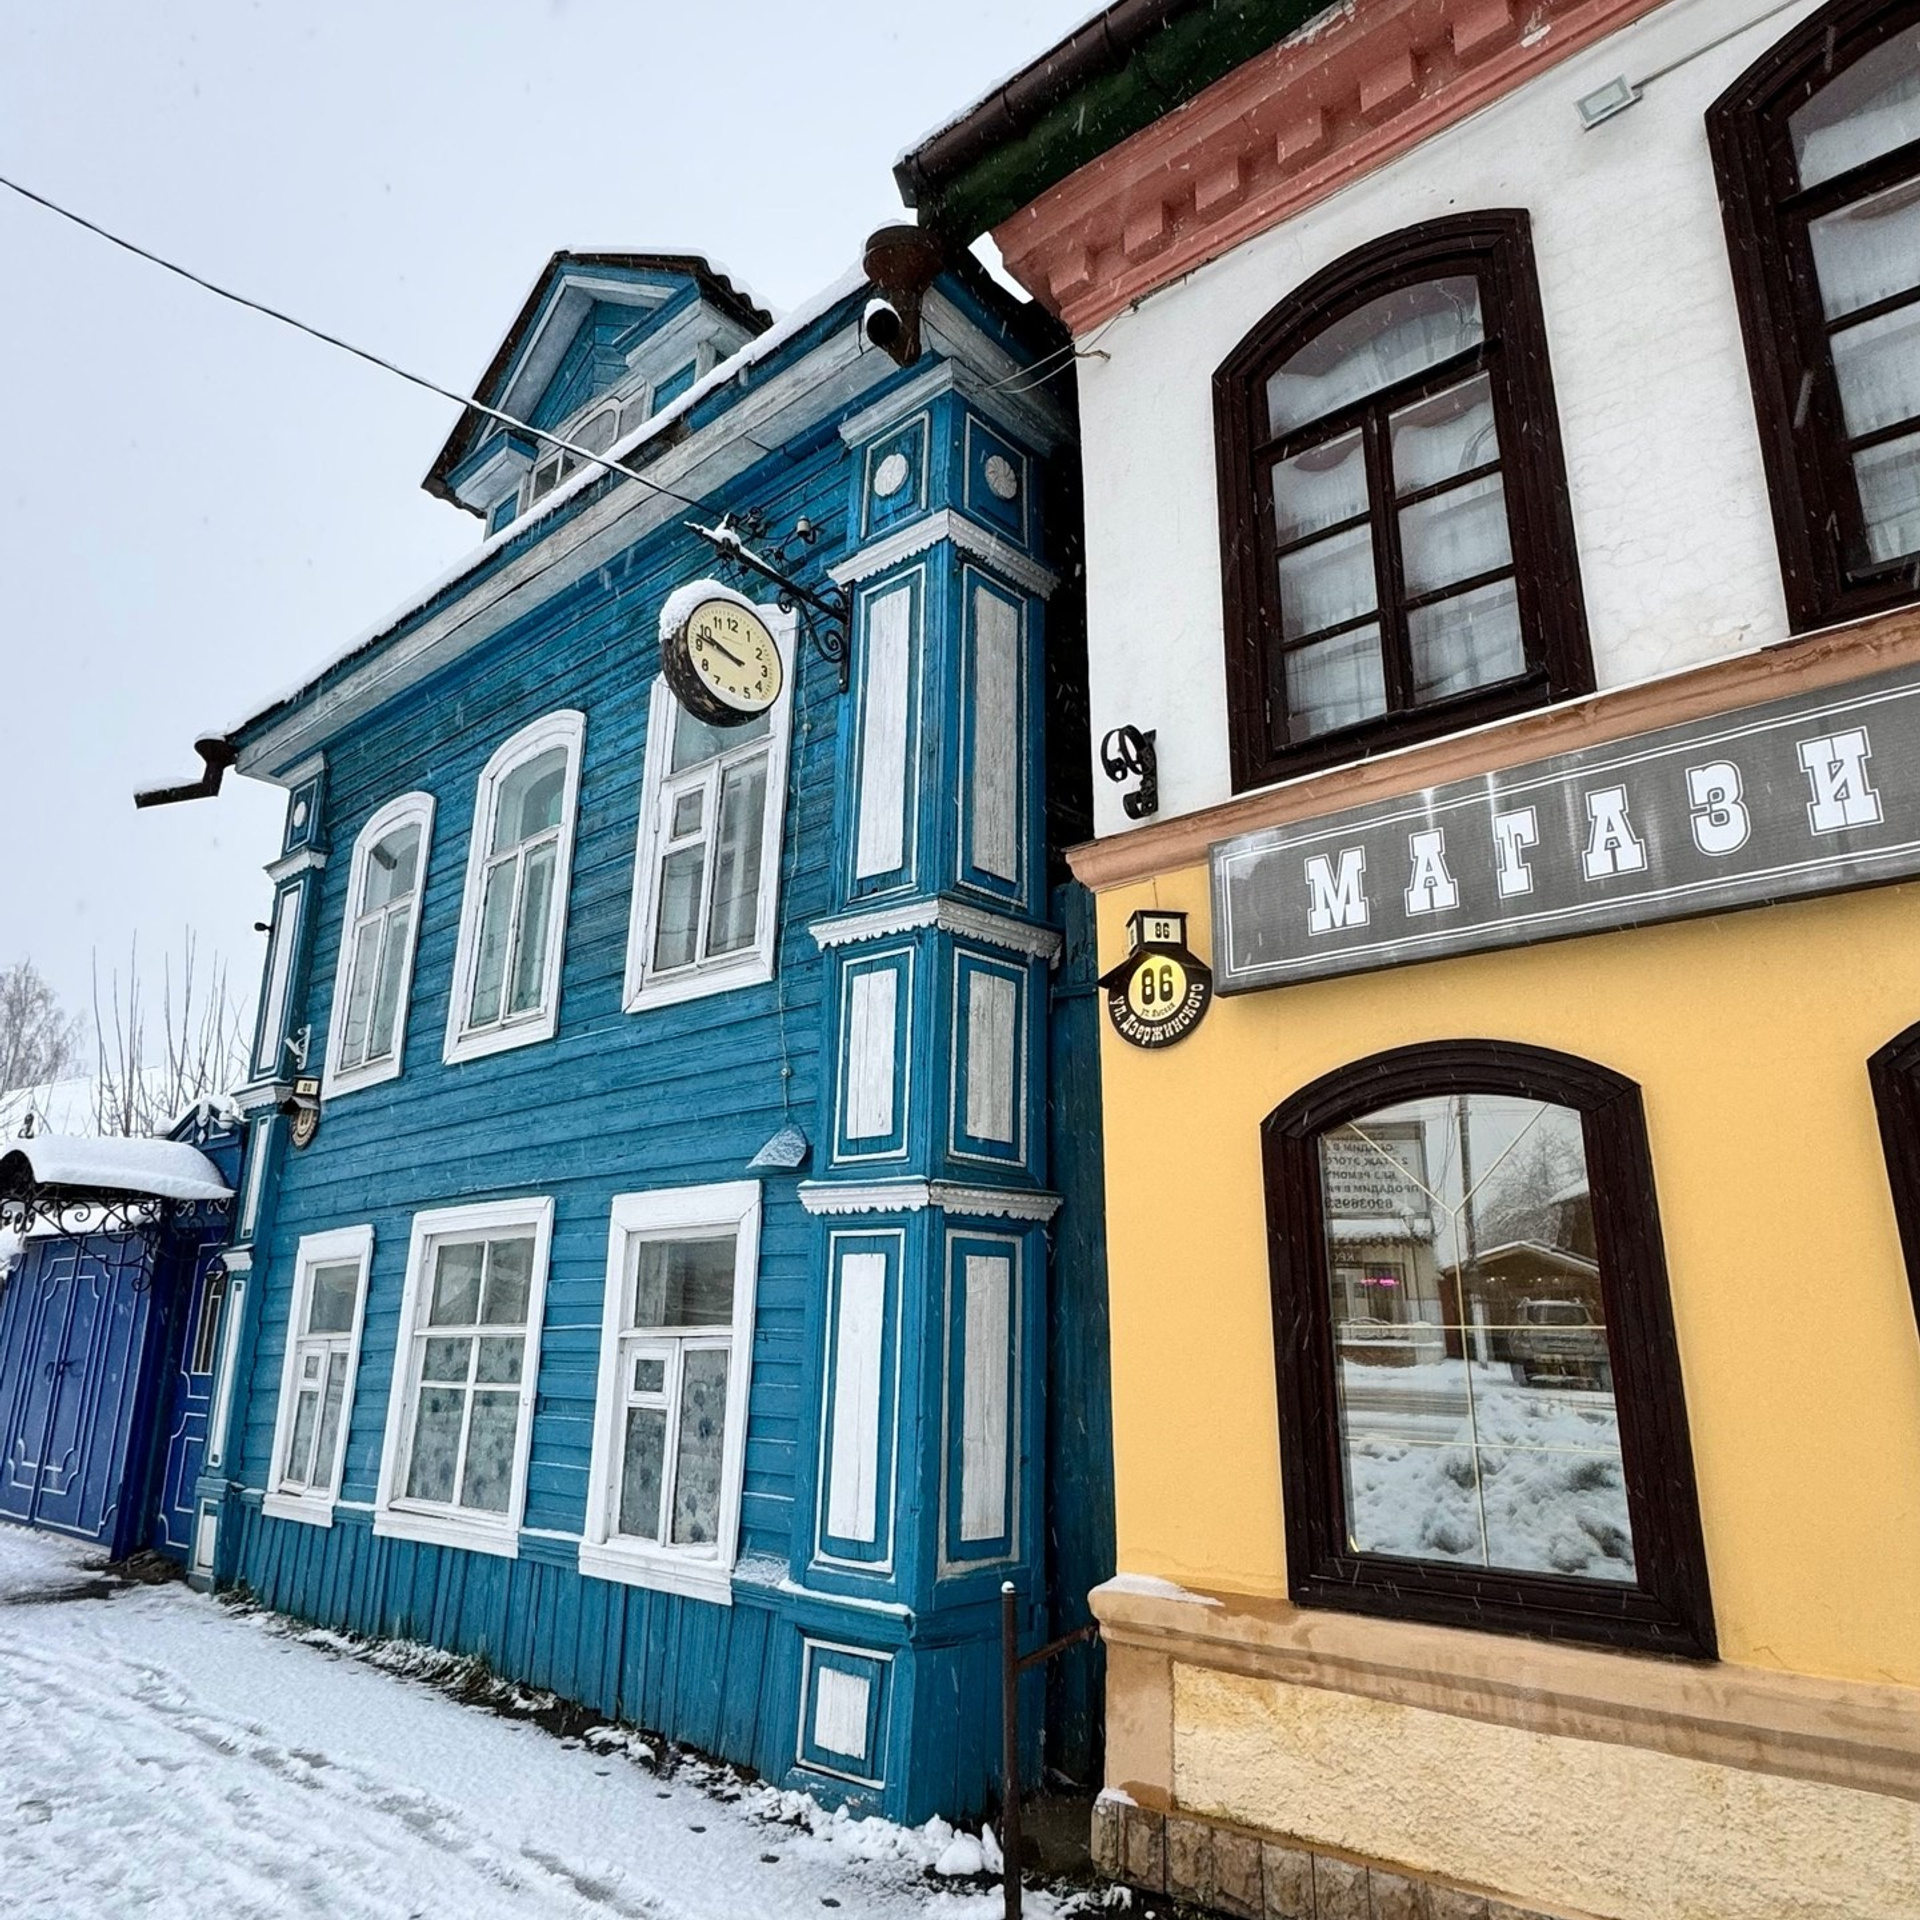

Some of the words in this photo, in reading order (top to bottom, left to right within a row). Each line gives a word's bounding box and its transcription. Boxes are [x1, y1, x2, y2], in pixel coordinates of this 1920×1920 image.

[713, 616, 723, 631] 11
[727, 617, 739, 633] 12
[700, 624, 712, 640] 10
[746, 630, 751, 642] 1
[695, 638, 703, 652] 9
[755, 647, 763, 661] 2
[701, 658, 709, 672] 8
[761, 665, 768, 678] 3
[713, 674, 721, 685] 7
[755, 680, 762, 693] 4
[743, 686, 751, 699] 5
[1305, 726, 1885, 936] МАГАЗИ
[1154, 922, 1170, 939] 86
[1141, 964, 1174, 1005] 86
[1109, 995, 1127, 1021] ул.
[1120, 983, 1205, 1045] Дзержинского
